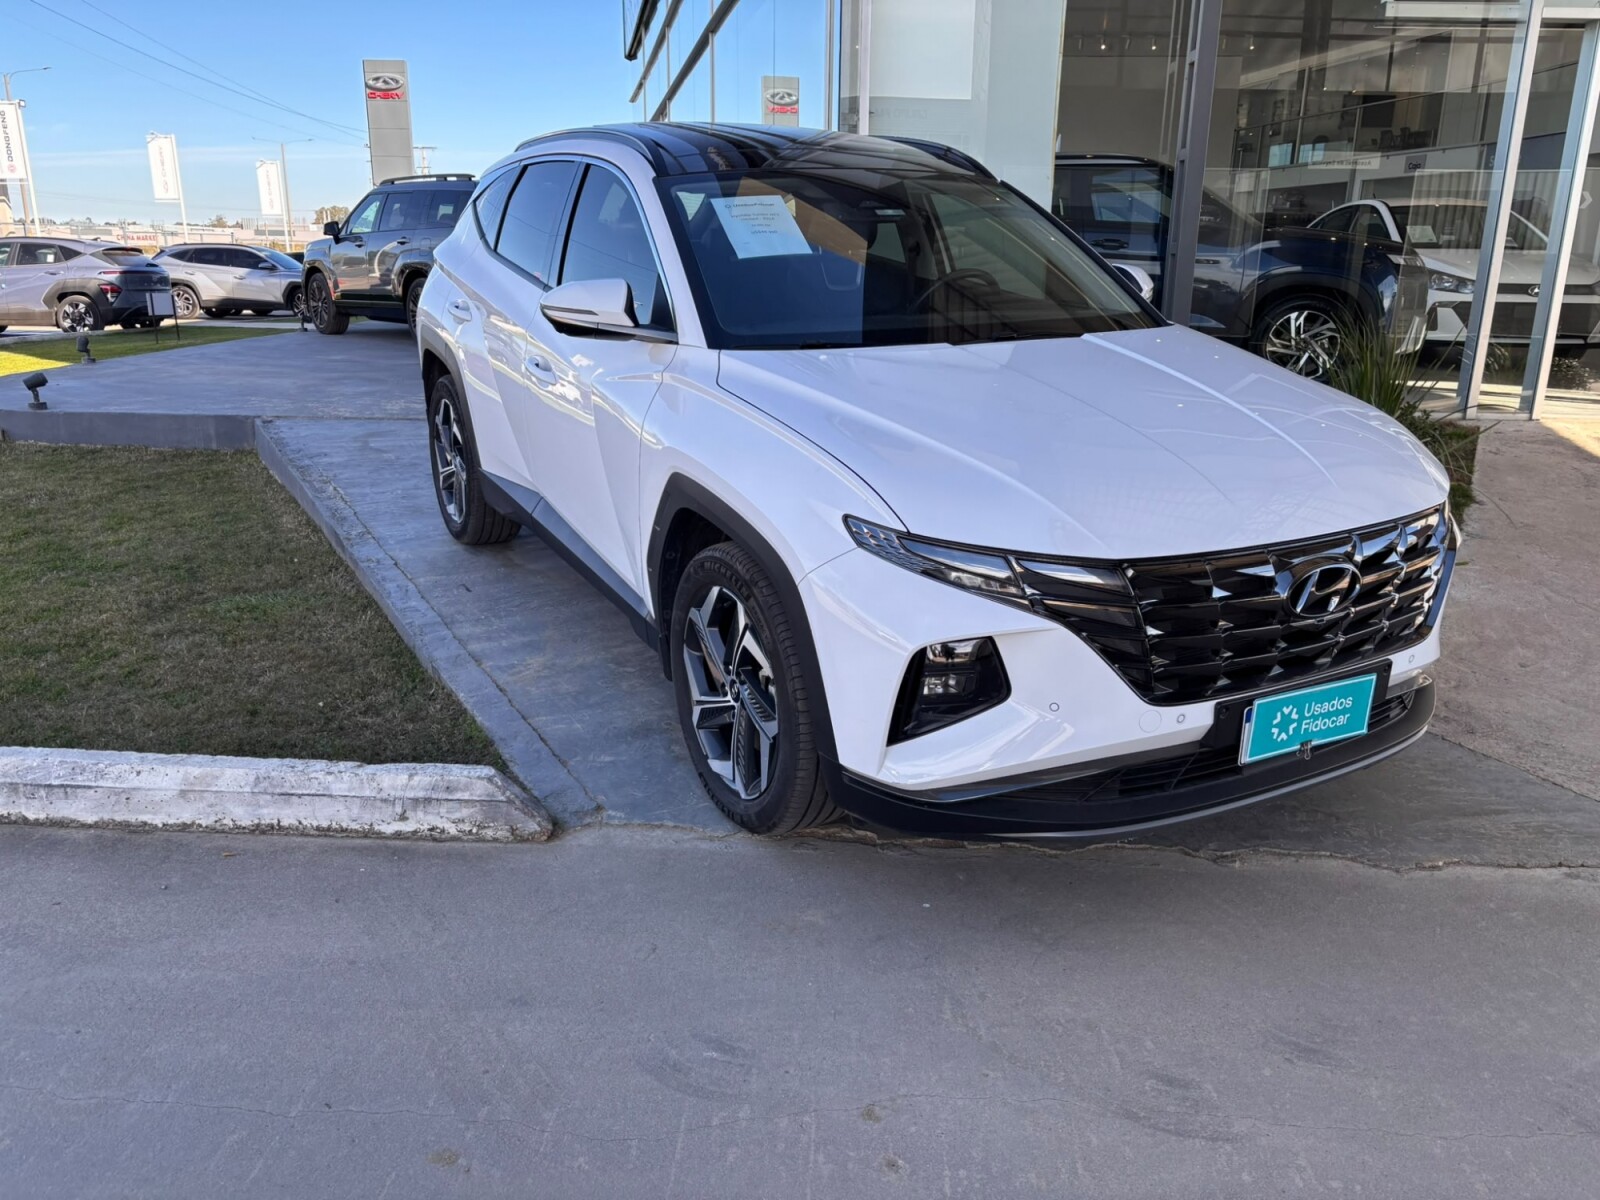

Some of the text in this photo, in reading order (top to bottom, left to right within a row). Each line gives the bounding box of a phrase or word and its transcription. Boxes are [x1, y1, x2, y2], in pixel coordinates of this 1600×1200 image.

[0, 110, 14, 162] DONGFENG
[1304, 695, 1353, 718] Usados
[1300, 713, 1350, 735] Fidocar
